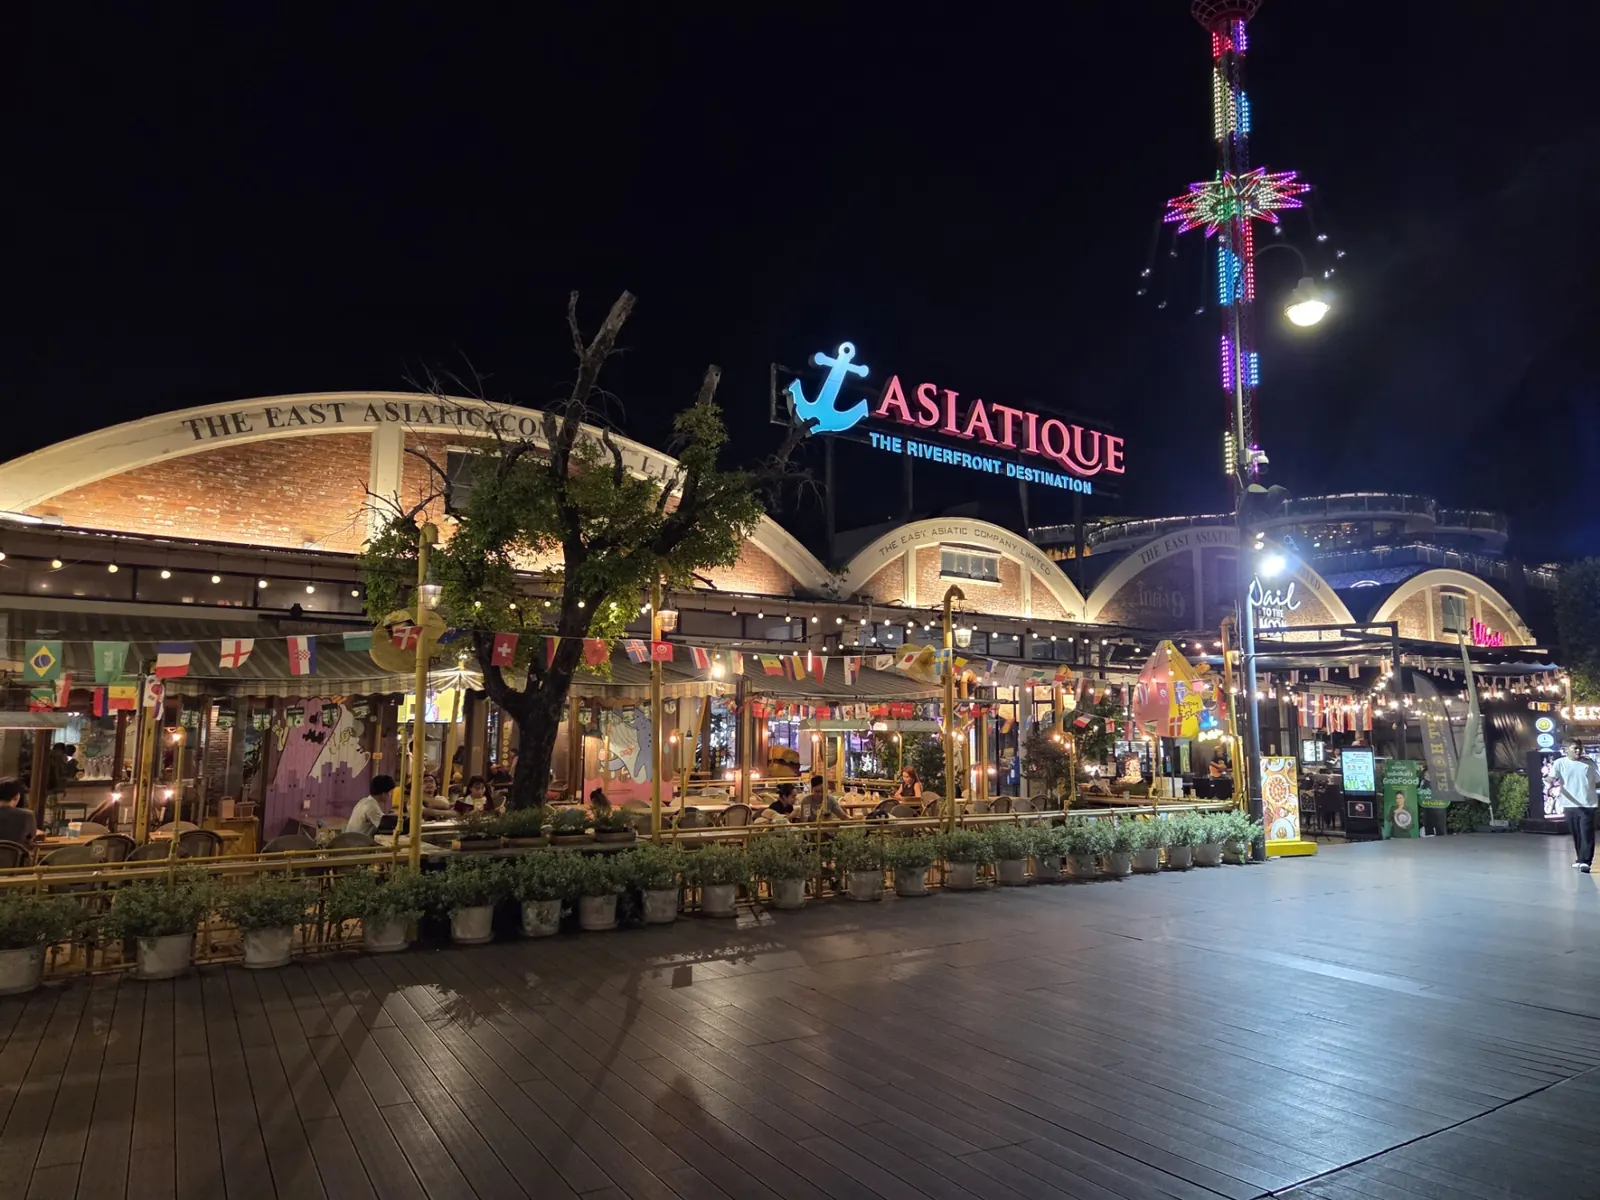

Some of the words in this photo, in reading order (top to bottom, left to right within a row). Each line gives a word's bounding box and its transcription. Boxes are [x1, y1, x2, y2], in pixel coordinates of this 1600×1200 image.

[181, 411, 253, 441] THE
[264, 402, 346, 428] EAST
[363, 402, 484, 428] ASIATIC
[874, 374, 1126, 476] ASIATIQUE
[868, 431, 902, 453] THE
[907, 440, 1002, 474] RIVERFRONT
[1006, 463, 1093, 494] DESTINATION
[879, 540, 899, 556] THE
[900, 530, 927, 544] EAST
[931, 526, 968, 536] ASIATIC
[974, 528, 1018, 551] COMPANY
[1020, 548, 1051, 576] LIMITED
[1138, 544, 1161, 564] THE
[1164, 534, 1190, 552] EAST
[1195, 530, 1234, 544] ASIATIC
